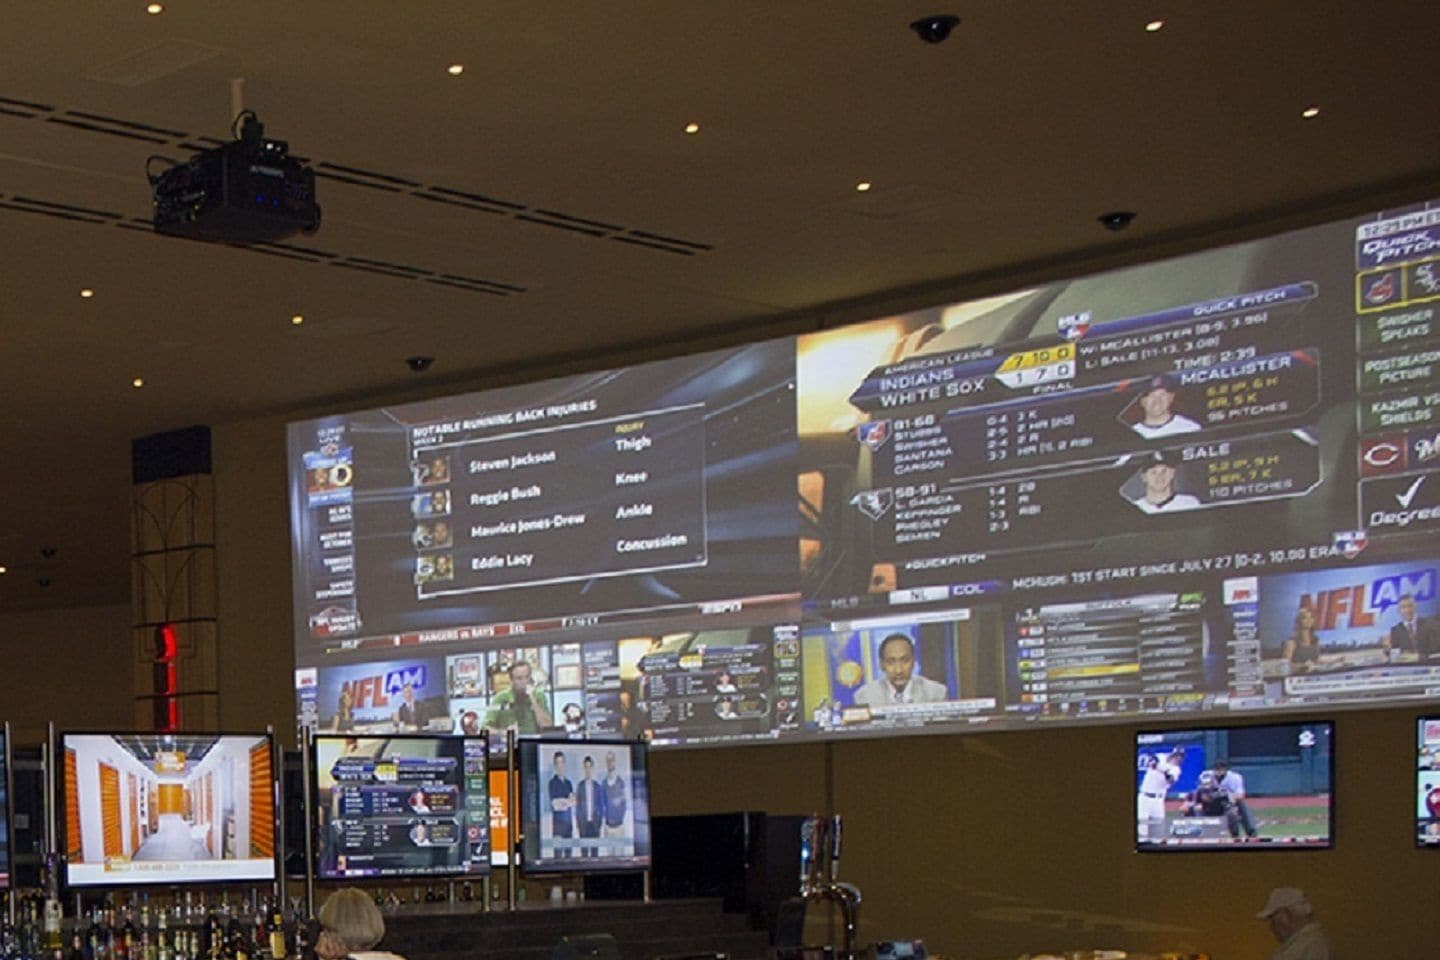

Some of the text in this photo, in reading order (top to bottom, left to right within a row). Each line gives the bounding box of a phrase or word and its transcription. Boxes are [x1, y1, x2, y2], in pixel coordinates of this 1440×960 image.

[1193, 290, 1286, 316] QUICK PITCH
[1100, 328, 1193, 353] MCALLISTER
[1381, 324, 1430, 342] SPEAKS
[880, 368, 955, 392] INDIANS
[1033, 351, 1049, 364] 10
[1057, 348, 1069, 360] 0
[884, 348, 994, 375] AMERICAN LEAGUE
[1101, 351, 1138, 366] SALE
[1174, 354, 1217, 371] TIME:
[1181, 355, 1292, 386] MCALLISTER
[881, 384, 941, 407] WHITE
[946, 379, 984, 398] SOX
[1057, 365, 1069, 377] 0
[1379, 366, 1431, 384] PICTURE
[1032, 382, 1073, 395] FINAL
[1229, 402, 1288, 418] PITCHES
[1371, 395, 1419, 413] KAZMIR
[413, 400, 598, 437] NOTABLE RUNNING BACK INJURIES
[1380, 408, 1432, 426] SHIELDS
[469, 436, 652, 473] Steven Jackson Thigh
[894, 448, 953, 464] SANTANA
[1182, 443, 1231, 461] SALE
[470, 470, 648, 507] Reggie Bush Knee
[1233, 478, 1293, 496] PITCHES
[471, 503, 653, 537] Maurice Jones-Drew Ankle
[471, 533, 688, 571] Eddie Lacy Concussion
[1073, 570, 1093, 584] 1ST
[1095, 566, 1136, 581] START
[1140, 562, 1177, 577] SINCE
[1179, 558, 1211, 574] JULY
[1215, 555, 1232, 569] 27
[952, 583, 985, 596] COL
[1295, 572, 1432, 632] NFL AM
[418, 628, 459, 642] RANGERS
[341, 676, 388, 708] NFL
